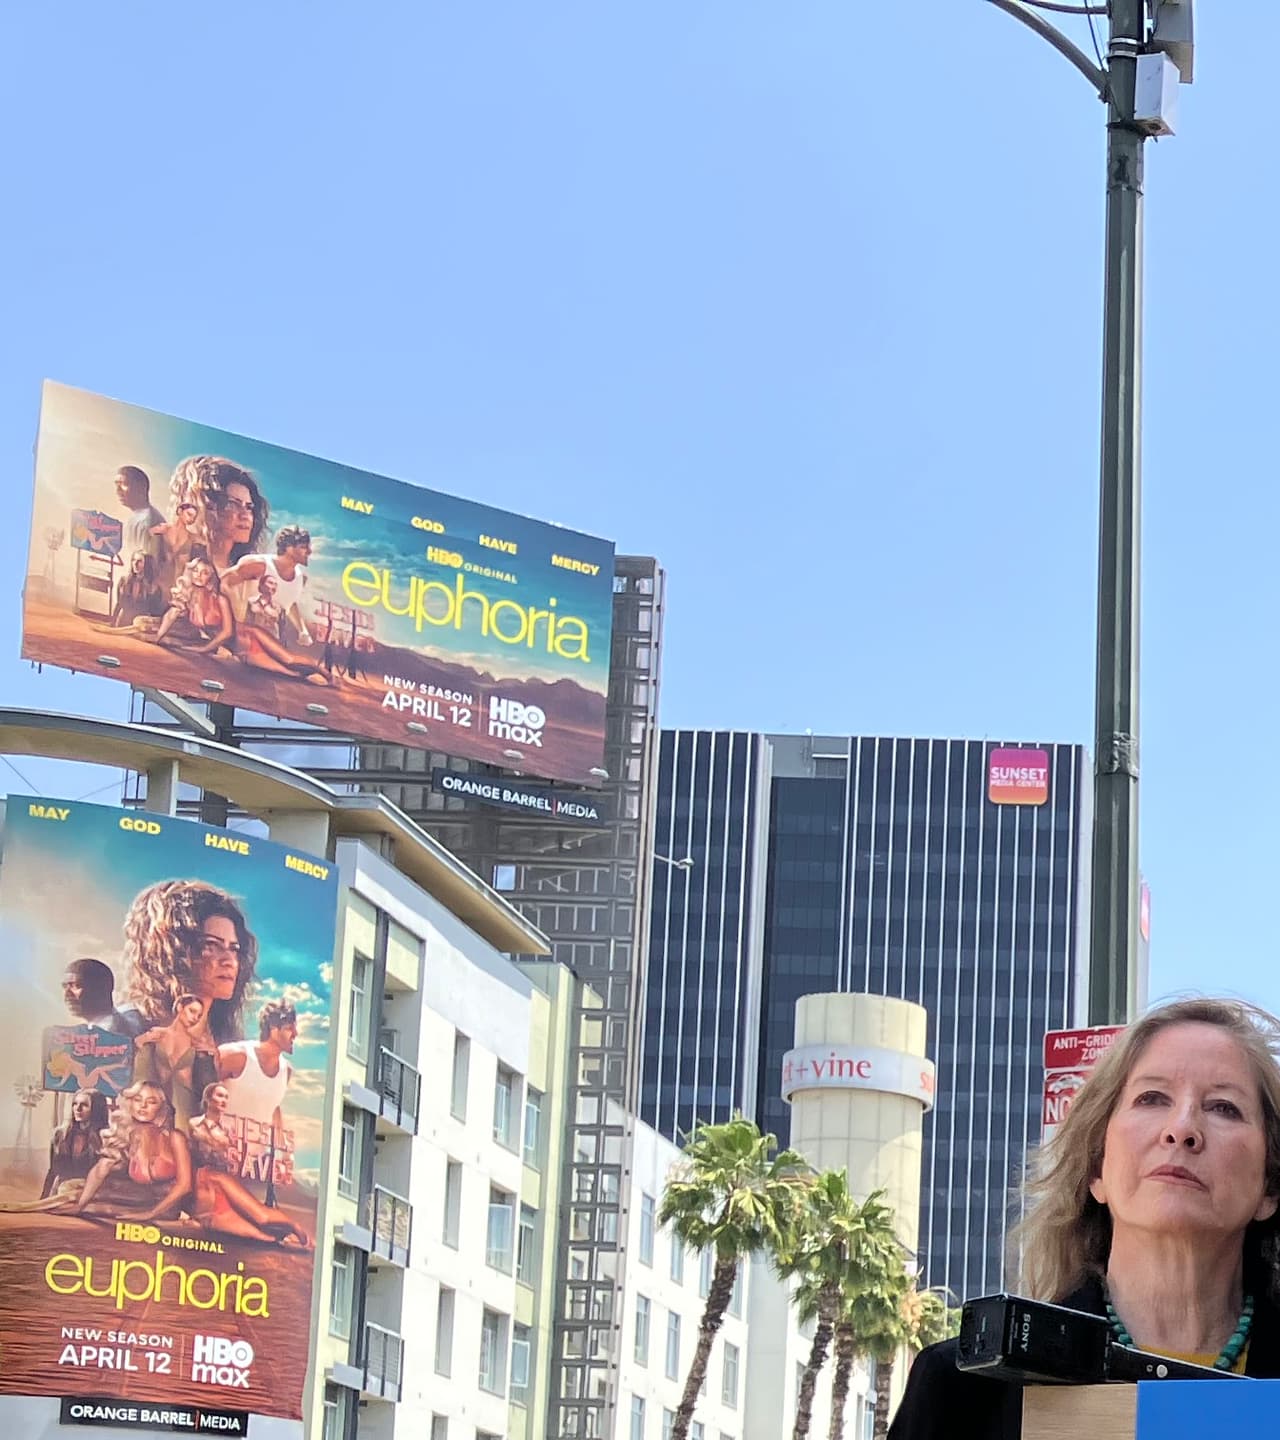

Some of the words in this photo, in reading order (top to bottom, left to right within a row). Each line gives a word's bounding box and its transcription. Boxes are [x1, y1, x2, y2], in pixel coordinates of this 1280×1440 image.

[341, 496, 374, 514] MAY
[411, 516, 444, 534] GOD
[479, 534, 517, 555] HAVE
[551, 554, 600, 576] MERCY
[427, 545, 463, 569] HBO
[464, 562, 518, 585] ORIGINAL
[342, 562, 591, 662] euphoria
[383, 674, 416, 690] NEW
[419, 683, 473, 706] SEASON
[382, 691, 445, 722] APRIL
[449, 705, 472, 728] 12
[489, 696, 546, 730] HBO
[488, 720, 543, 747] max
[990, 766, 1047, 780] SUNSET
[442, 776, 500, 801] ORANGE
[503, 789, 552, 811] BARREL
[557, 802, 598, 820] MEDIA
[28, 804, 71, 821] MAY
[119, 817, 161, 835] GOD
[205, 833, 250, 855] HAVE
[285, 855, 328, 880] MERCY
[811, 1052, 872, 1079] vine
[115, 1222, 161, 1244] HBO
[162, 1236, 224, 1254] ORIGINAL
[45, 1250, 269, 1318] euphoria
[61, 1327, 101, 1342] NEW
[107, 1331, 173, 1348] SEASON
[1020, 1313, 1031, 1352] SONY
[58, 1344, 138, 1371] APRIL
[145, 1351, 171, 1374] 12
[194, 1335, 254, 1368] HBO
[191, 1364, 250, 1388] max
[70, 1405, 137, 1421] ORANGE
[140, 1409, 194, 1427] BARREL
[200, 1414, 240, 1431] MEDIA
